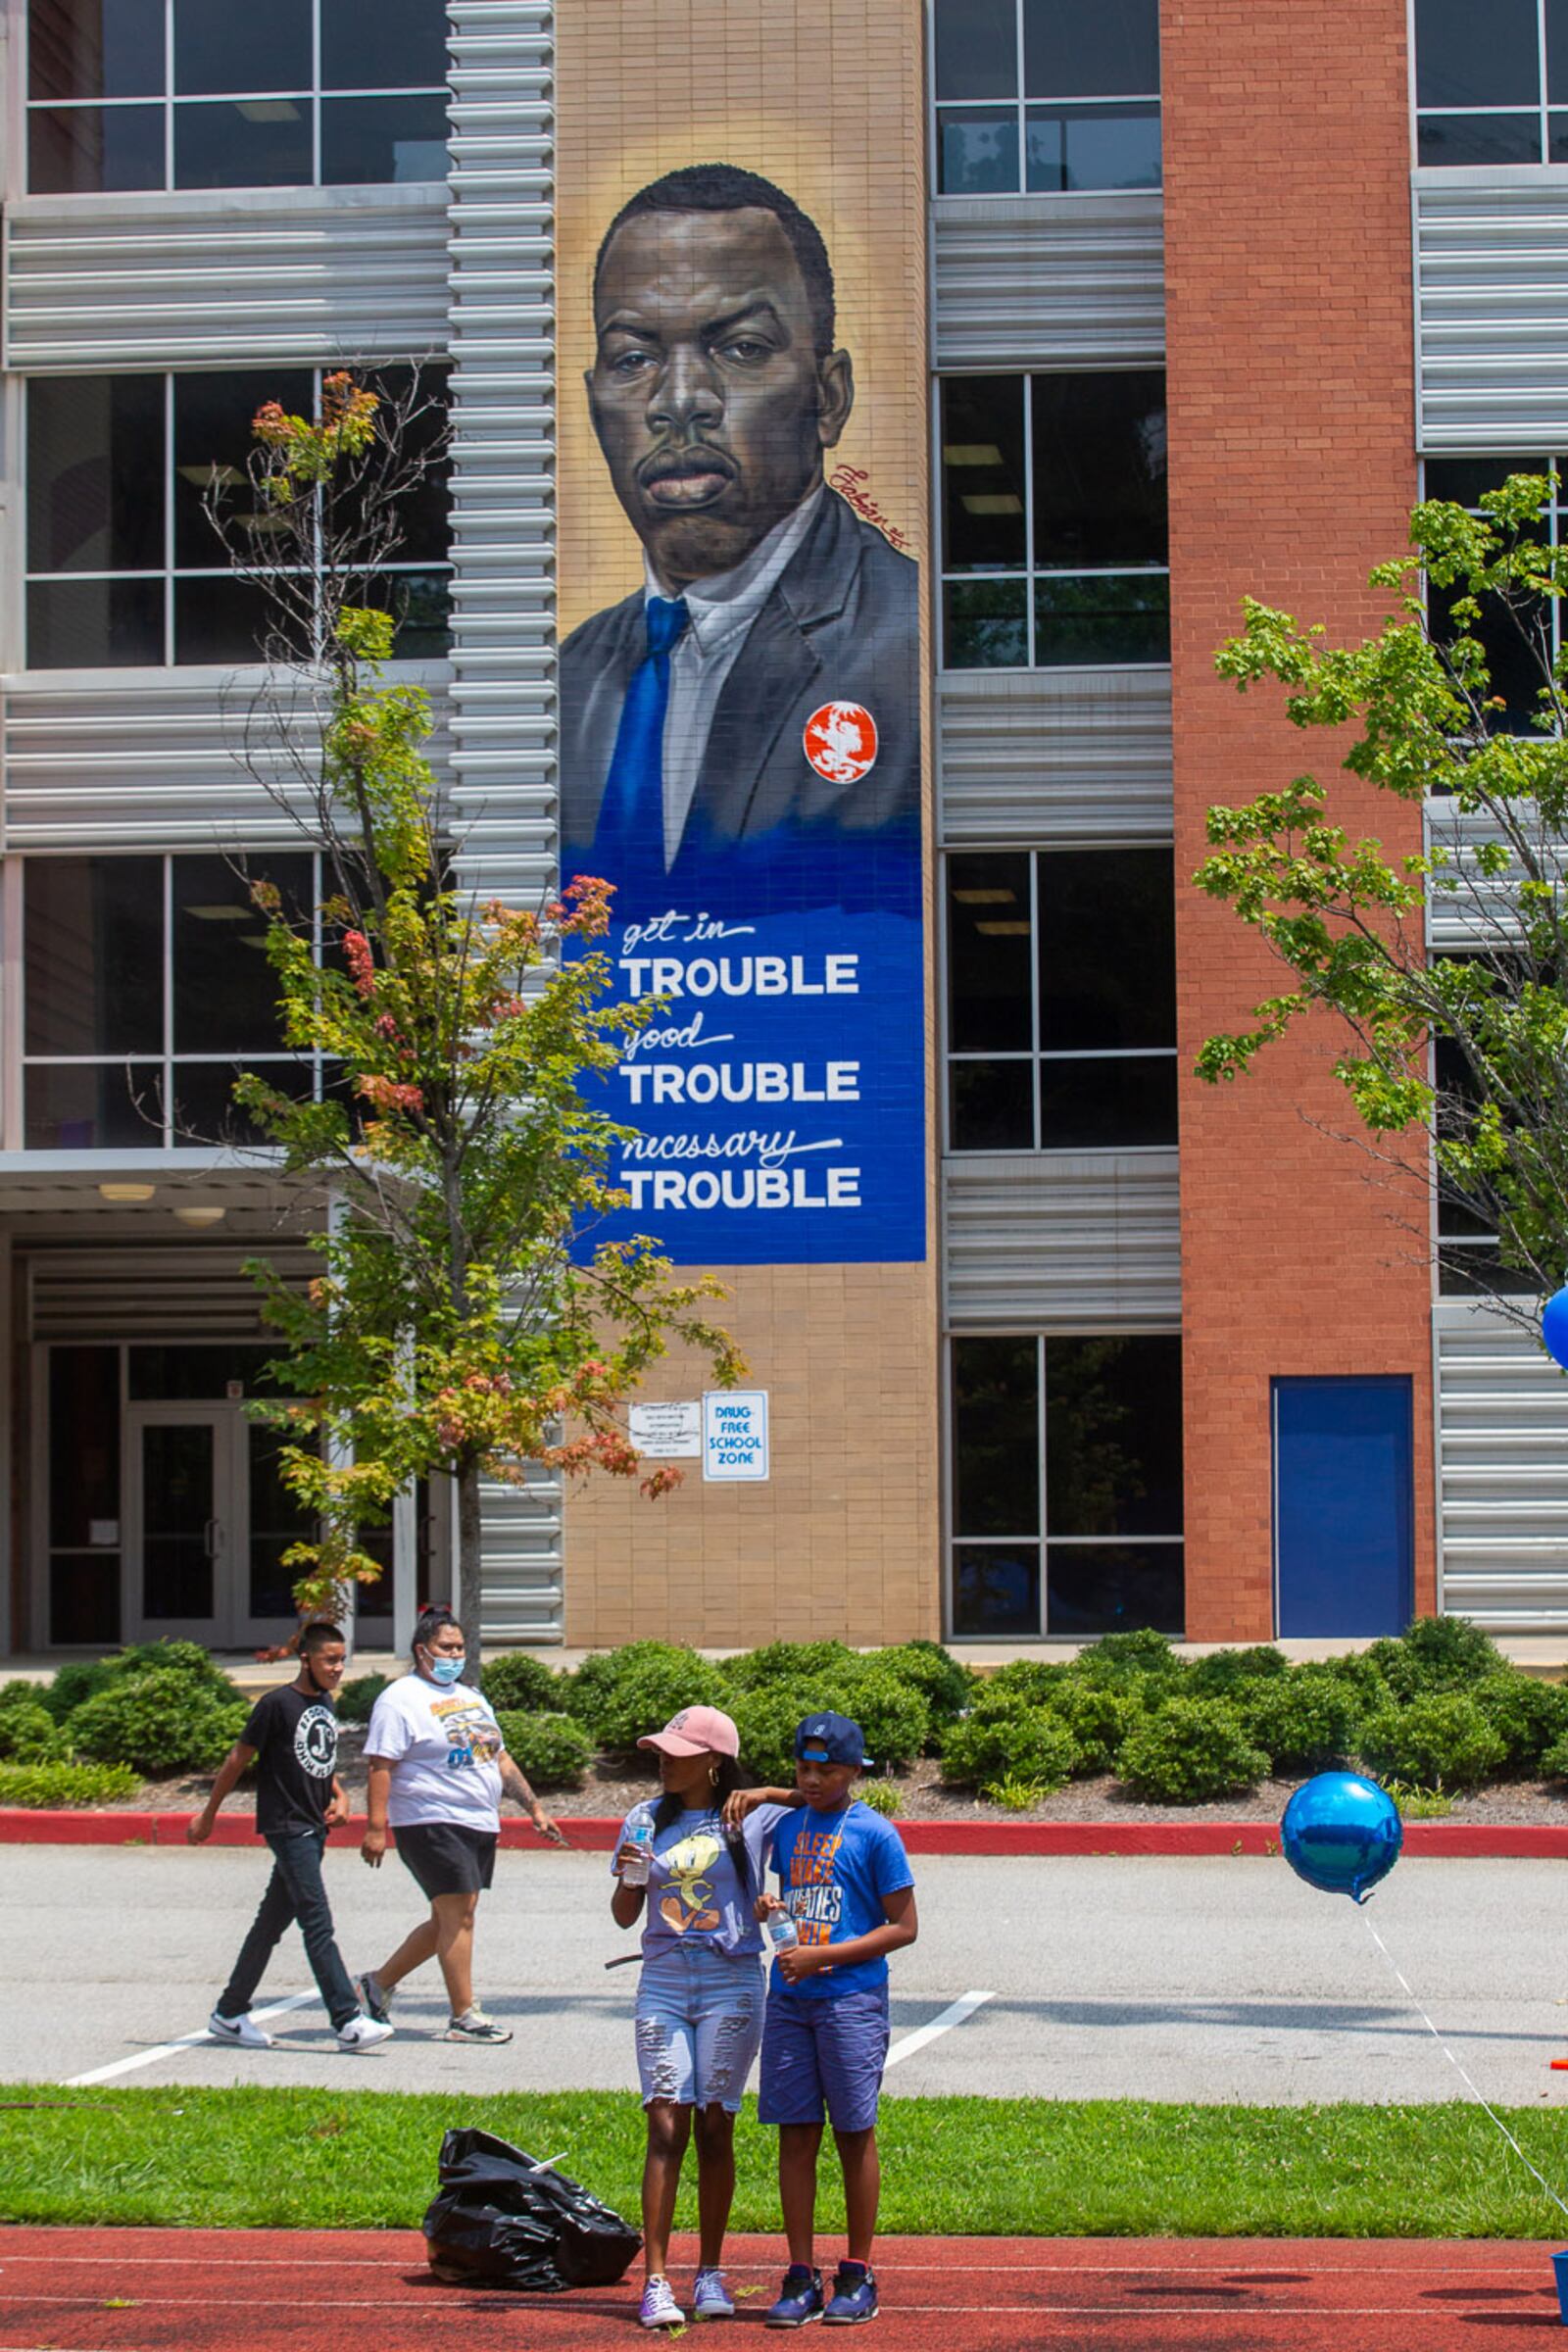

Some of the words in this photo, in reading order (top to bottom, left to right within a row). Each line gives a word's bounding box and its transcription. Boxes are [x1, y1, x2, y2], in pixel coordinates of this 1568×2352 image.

[622, 910, 690, 955] get
[684, 912, 756, 942] in
[618, 955, 858, 997] TROUBLE
[619, 1061, 859, 1103] TROUBLE
[620, 1130, 843, 1169] necessary
[620, 1167, 860, 1209] TROUBLE
[715, 1406, 752, 1418] DRUG
[721, 1421, 751, 1433] FREE
[710, 1437, 761, 1449] SCHOOL
[718, 1452, 754, 1464] ZONE
[793, 1830, 843, 1857] SLEEP
[790, 1857, 834, 1886] WAKE
